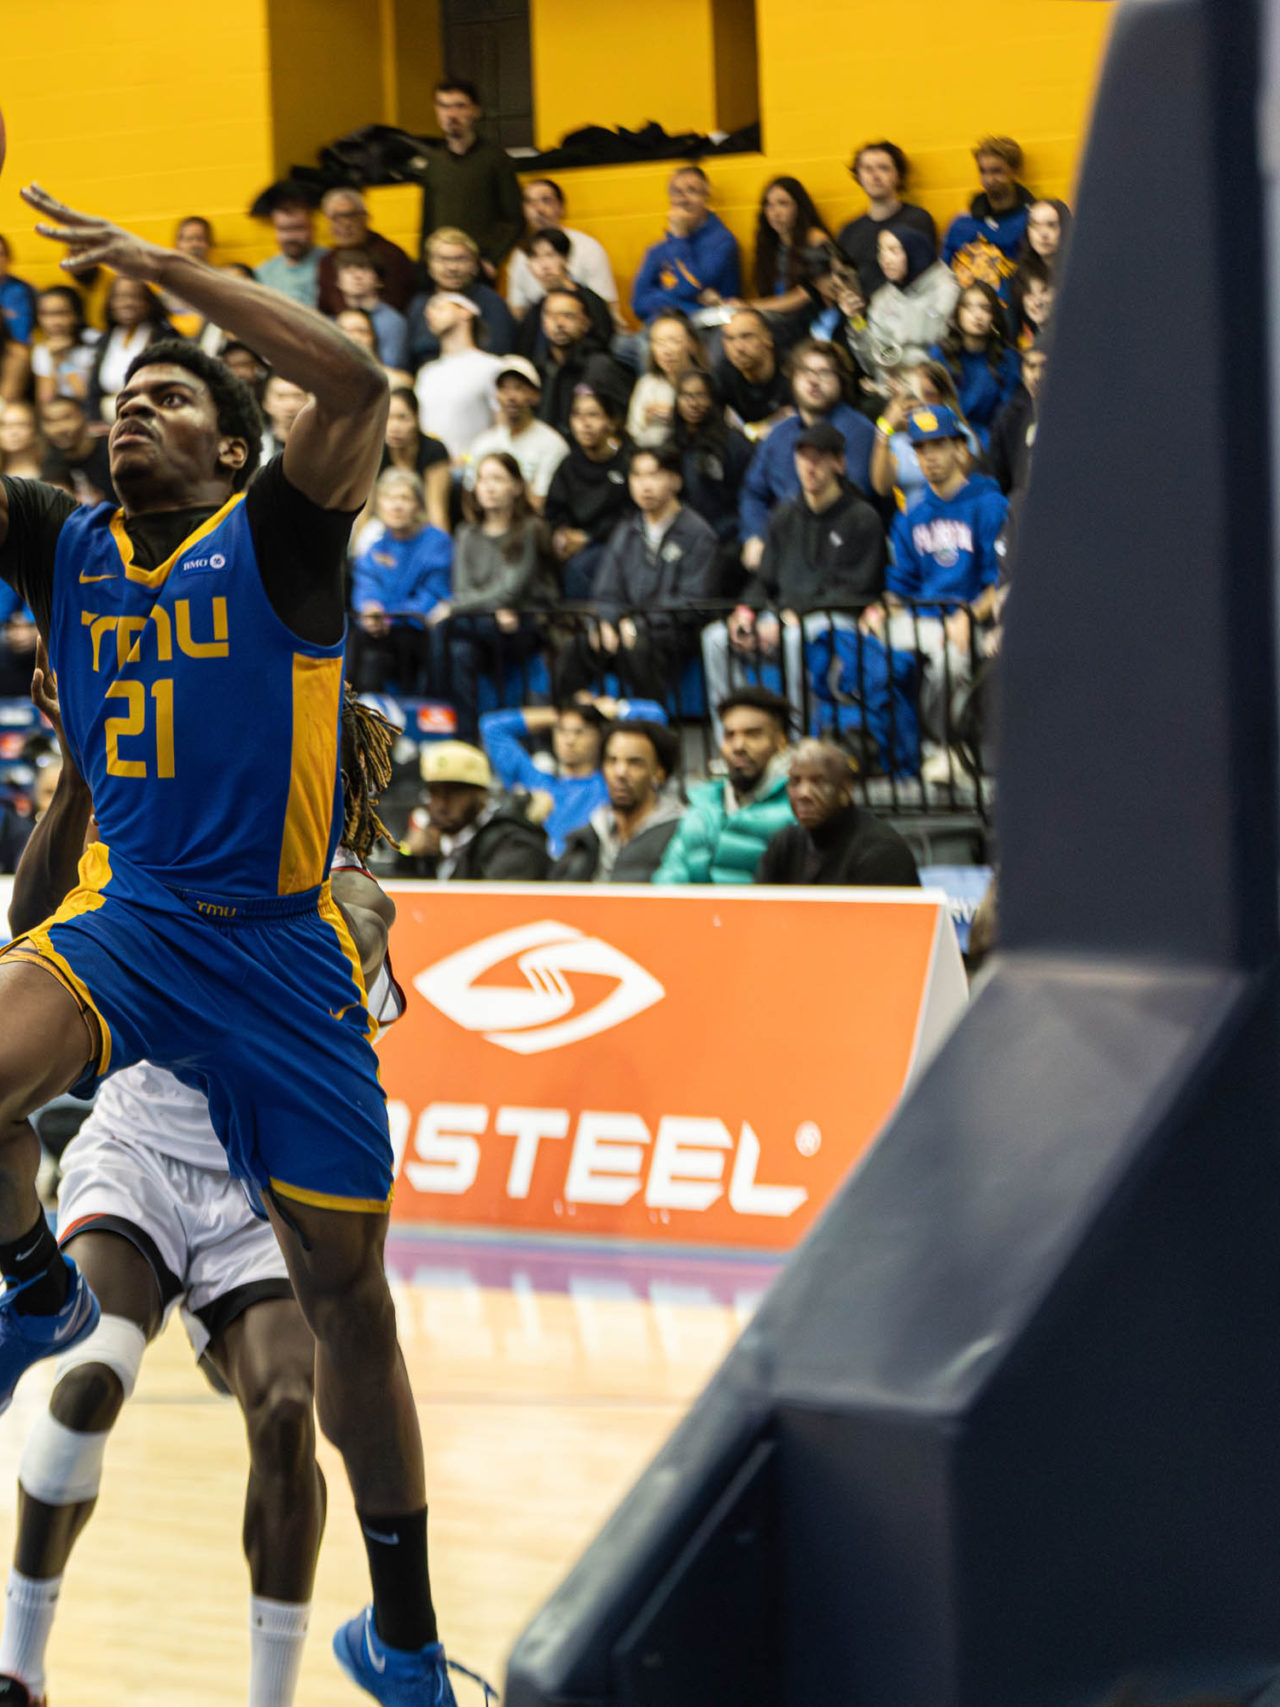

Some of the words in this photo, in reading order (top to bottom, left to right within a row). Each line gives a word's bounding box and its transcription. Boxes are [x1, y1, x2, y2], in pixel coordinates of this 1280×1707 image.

[183, 558, 208, 571] BMO
[81, 596, 229, 672] TMU
[104, 678, 175, 779] 21
[196, 900, 237, 918] TMU
